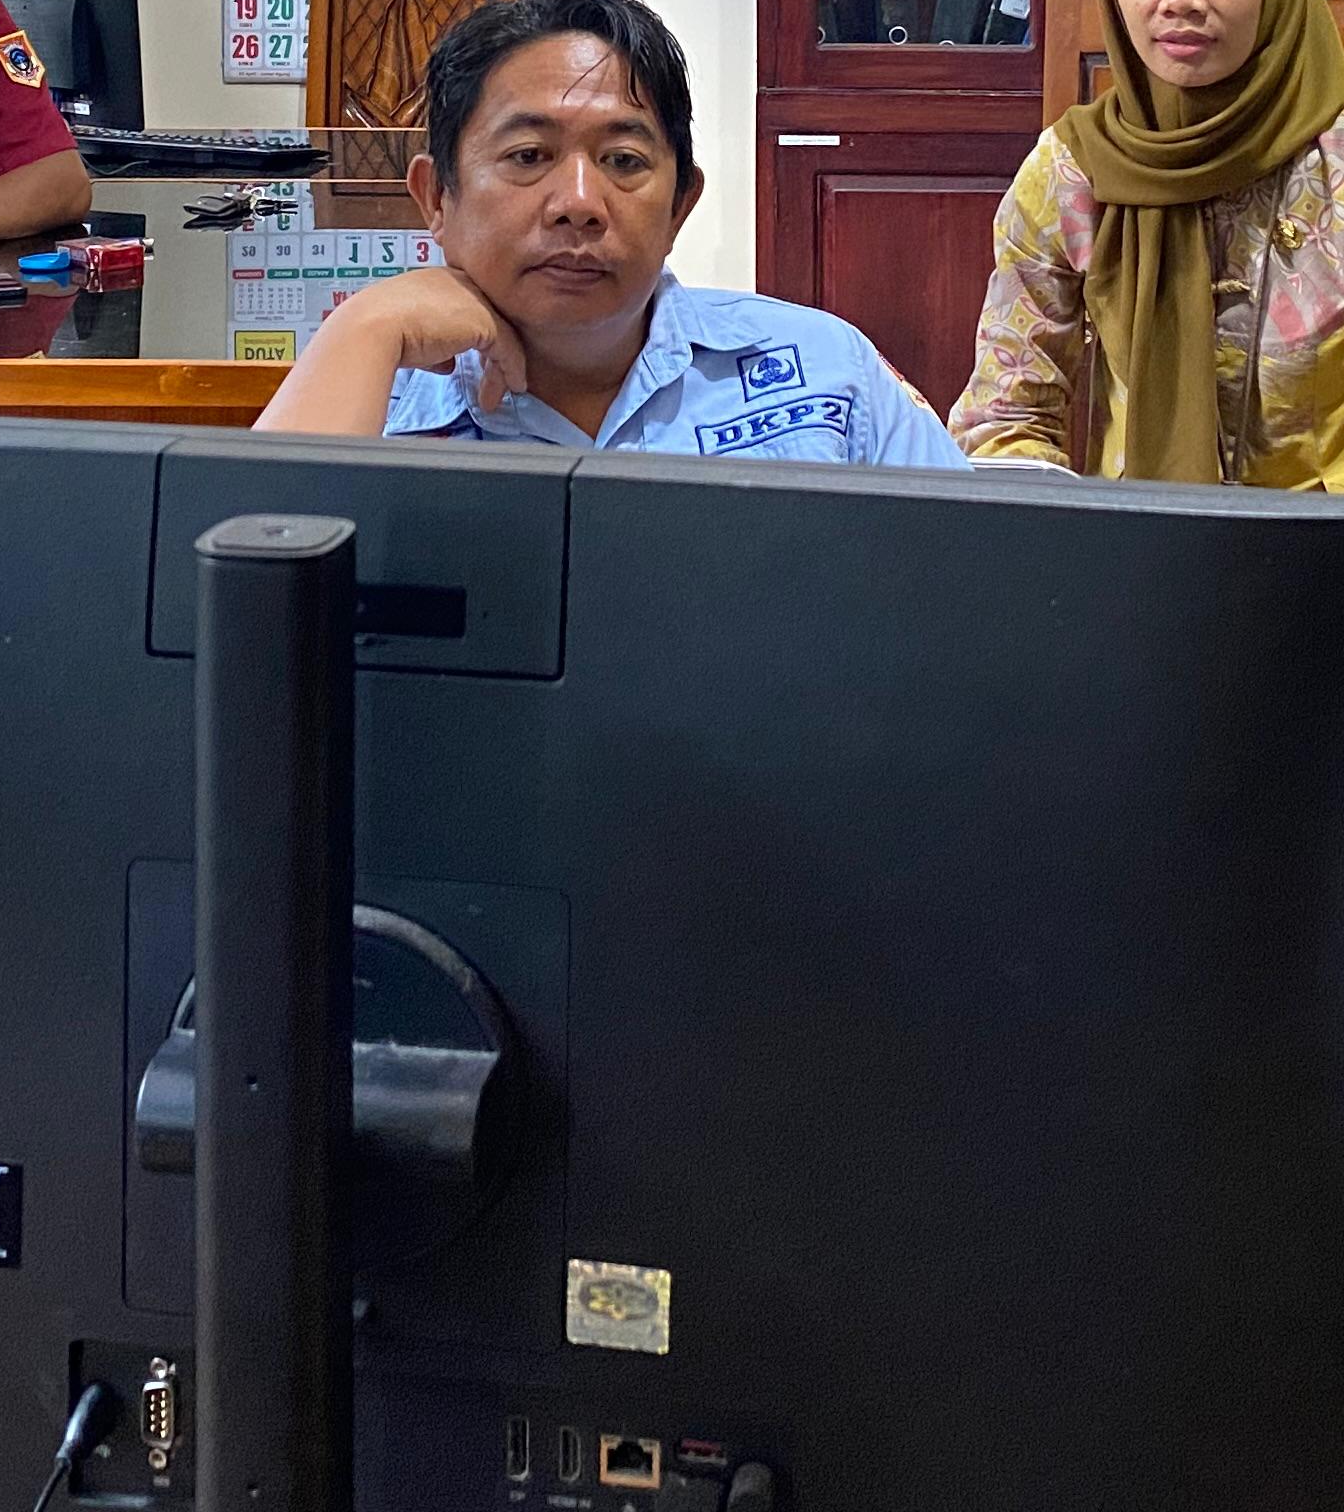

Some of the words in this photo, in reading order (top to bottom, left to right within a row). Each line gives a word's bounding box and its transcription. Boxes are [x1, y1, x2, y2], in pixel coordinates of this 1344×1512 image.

[232, 35, 258, 58] 26
[269, 35, 292, 58] 27
[713, 401, 843, 446] DKP2
